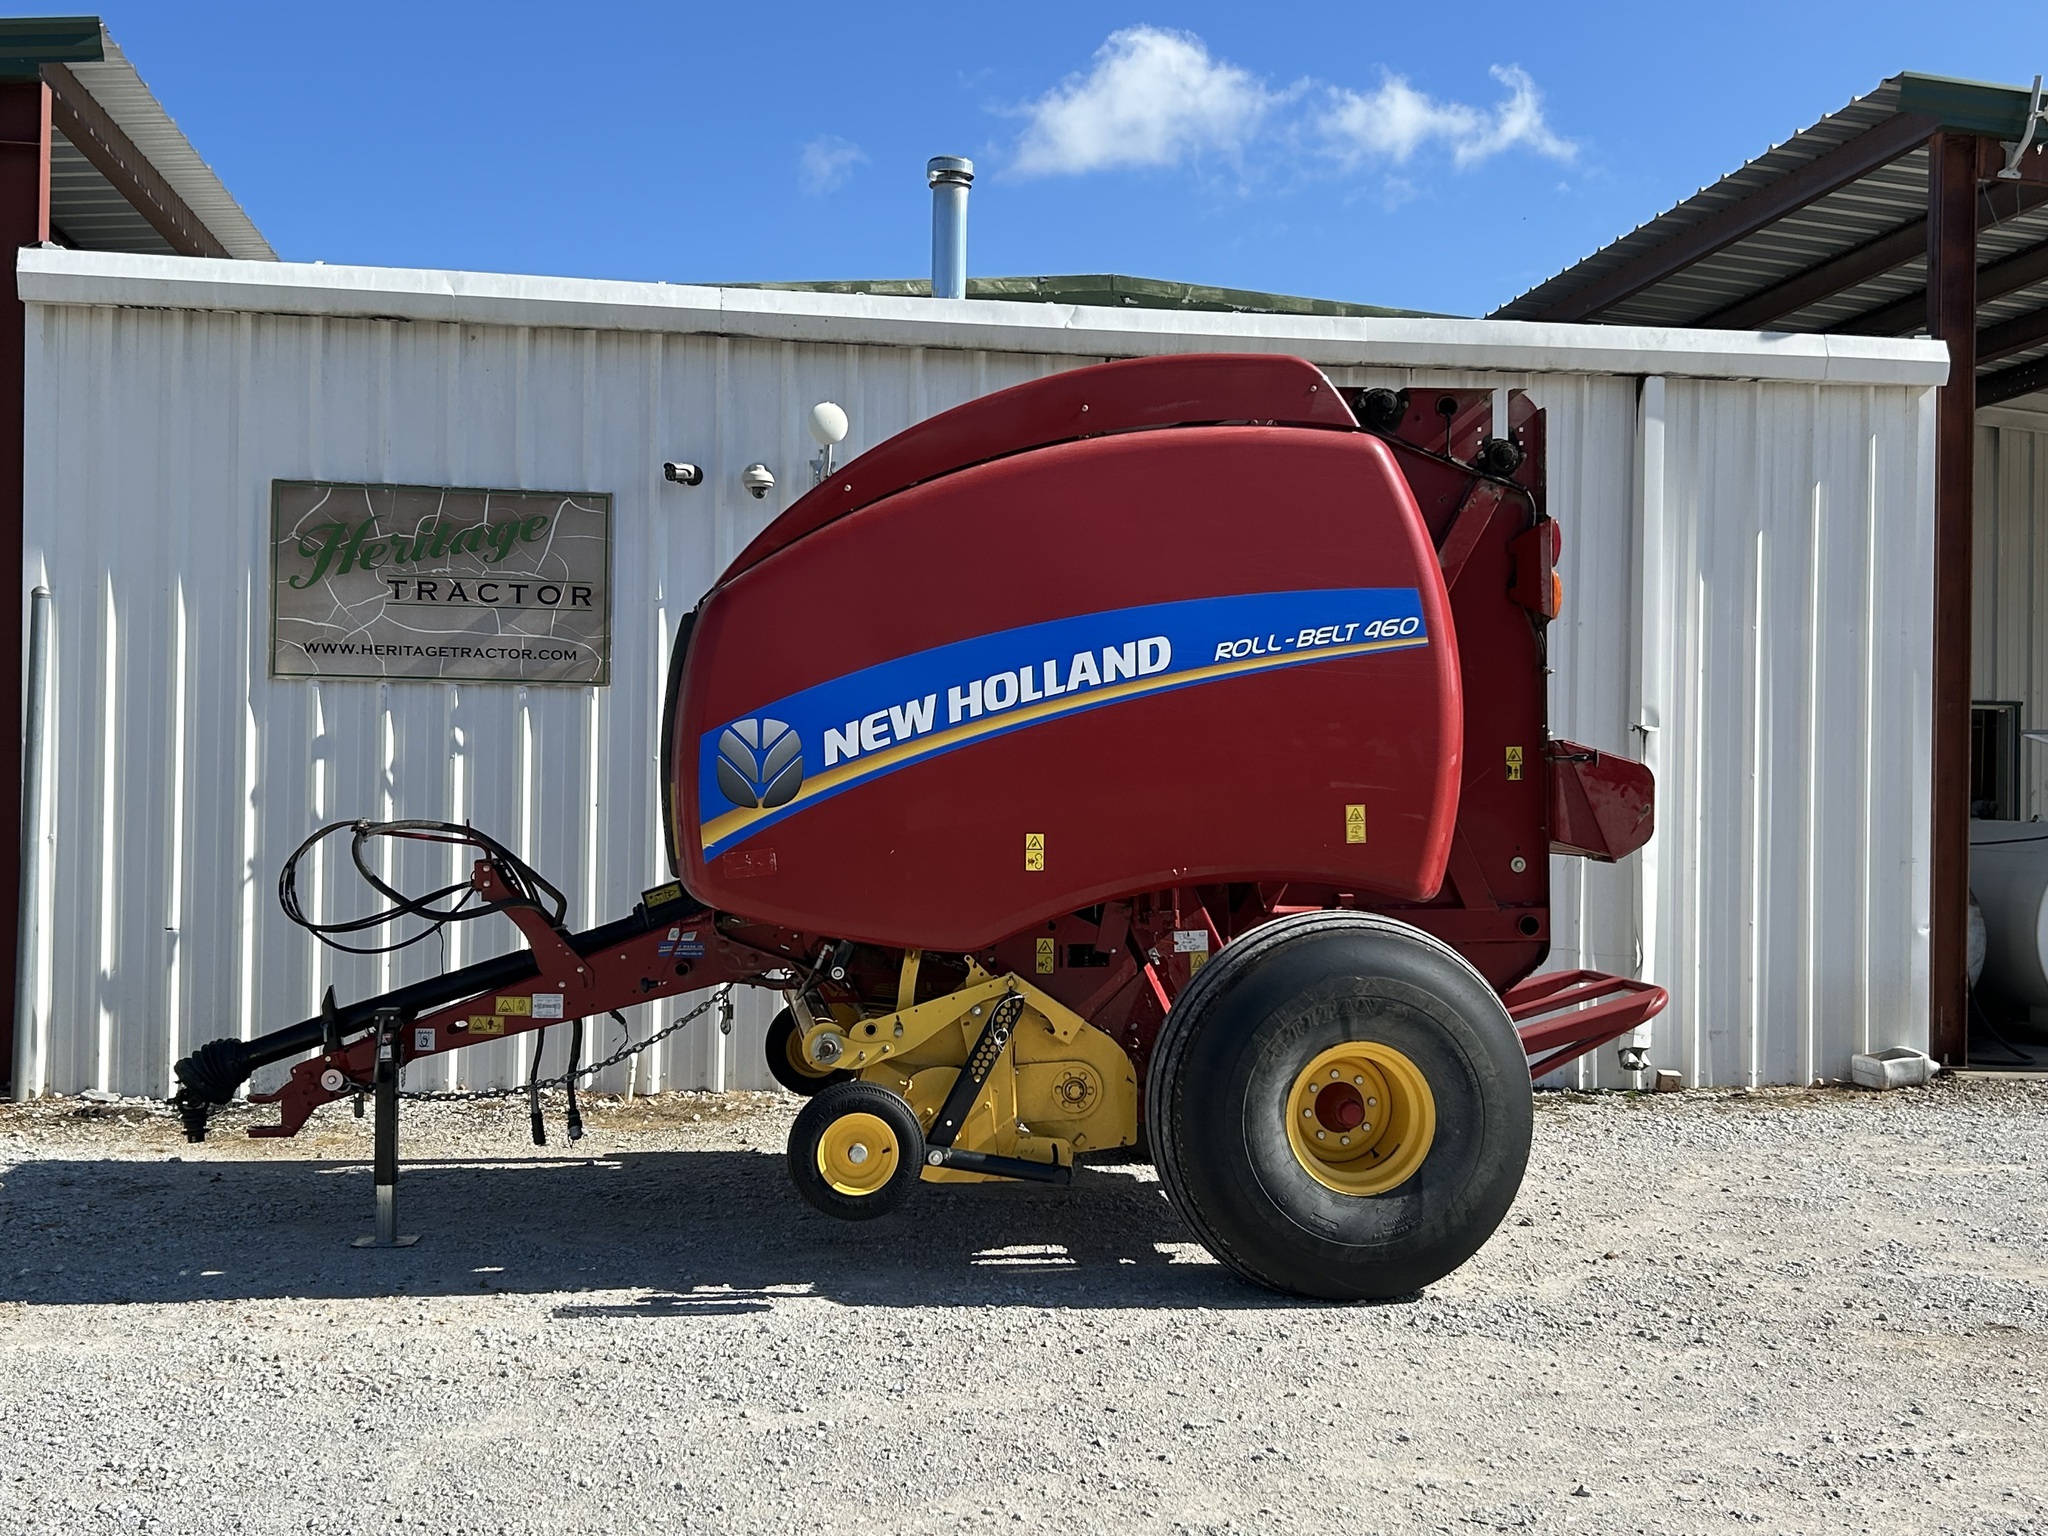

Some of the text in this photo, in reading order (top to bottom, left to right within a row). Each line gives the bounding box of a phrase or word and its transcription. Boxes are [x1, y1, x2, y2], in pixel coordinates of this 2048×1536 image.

[288, 514, 551, 589] Heritage
[386, 578, 593, 607] TRACTOR
[303, 641, 577, 661] WWW.HERITAGETRACTOR.COM
[1214, 617, 1420, 662] ROLL-BELT 460
[824, 635, 1172, 767] NEW HOLLAND
